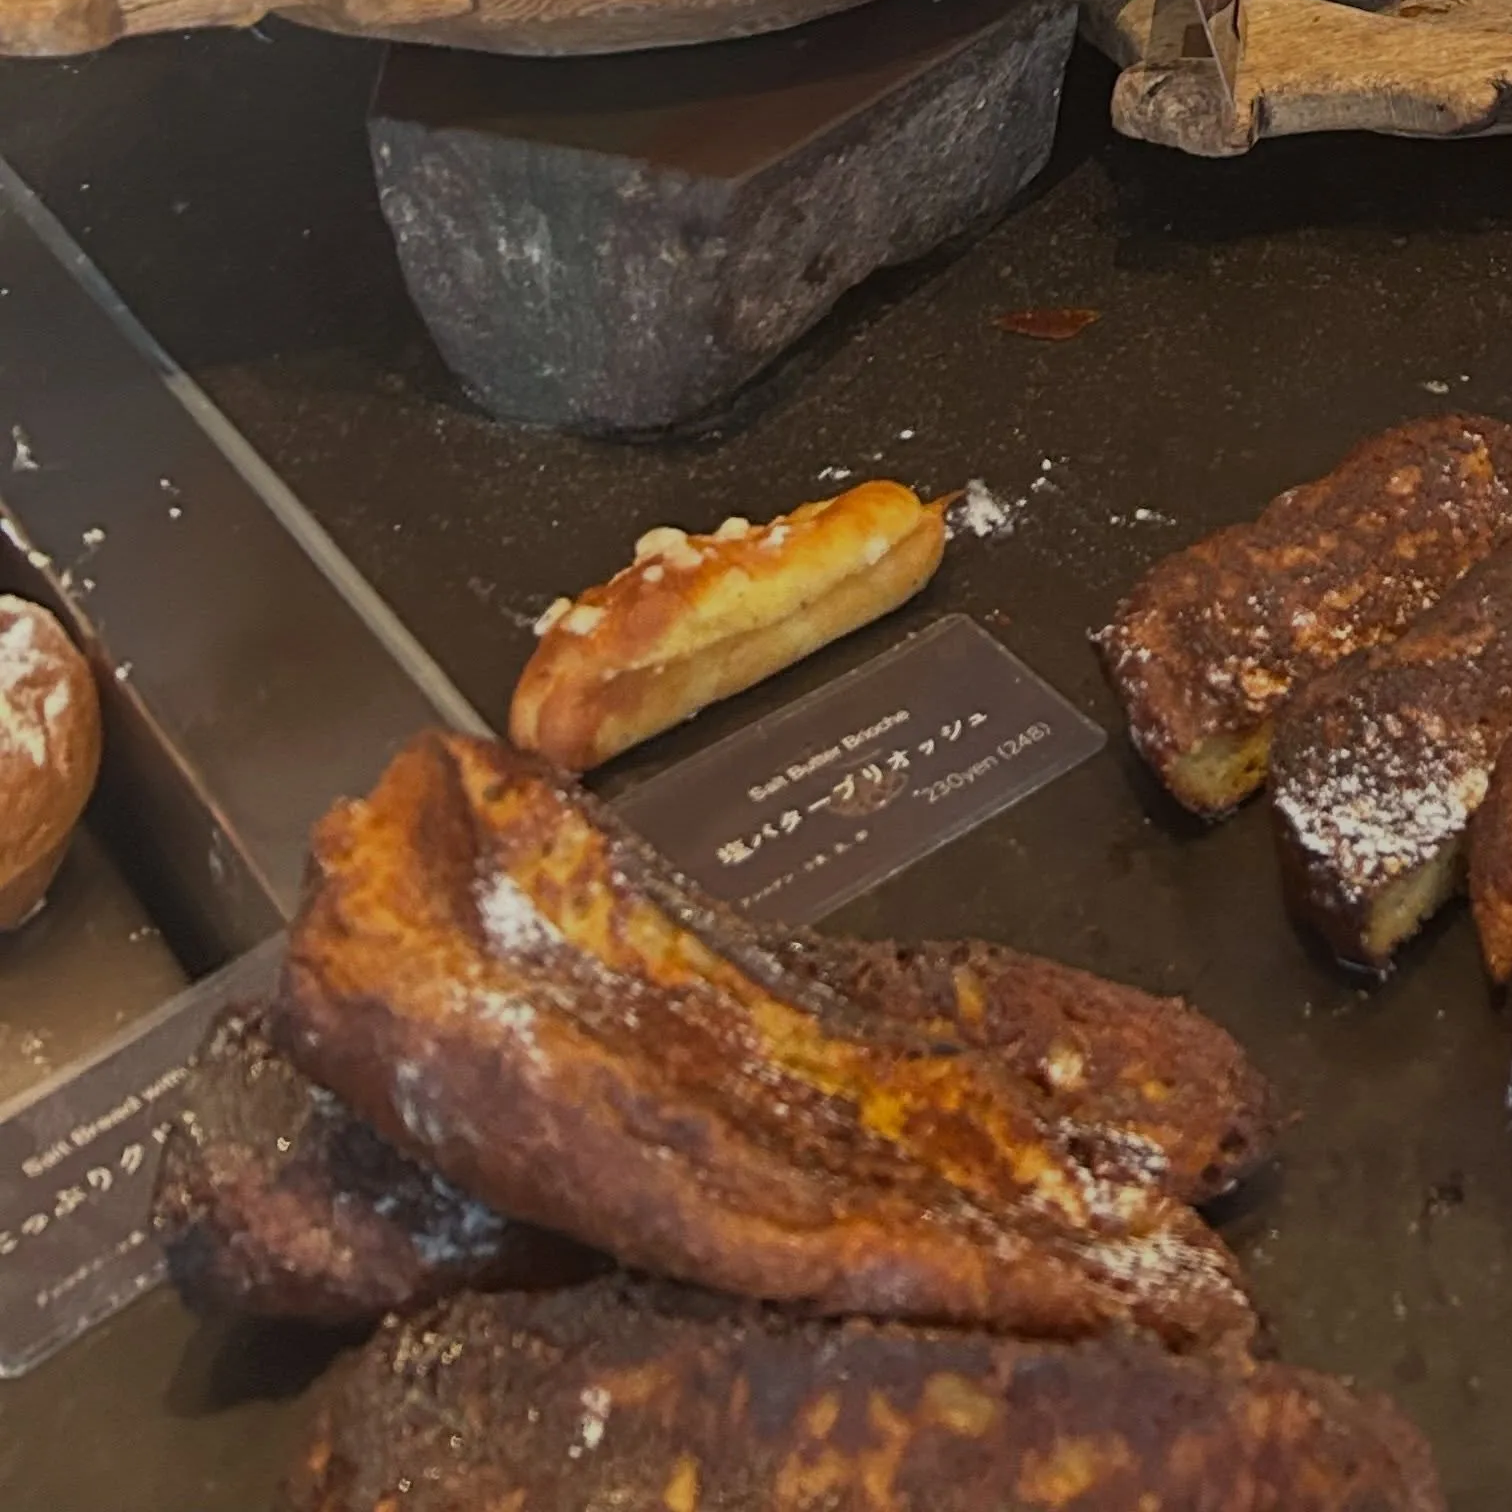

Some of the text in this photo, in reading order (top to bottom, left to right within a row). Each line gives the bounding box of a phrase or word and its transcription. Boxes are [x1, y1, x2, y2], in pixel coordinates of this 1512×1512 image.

[716, 711, 989, 865] 塩バターブリオッシュ
[918, 720, 1053, 804] 230yen (248)
